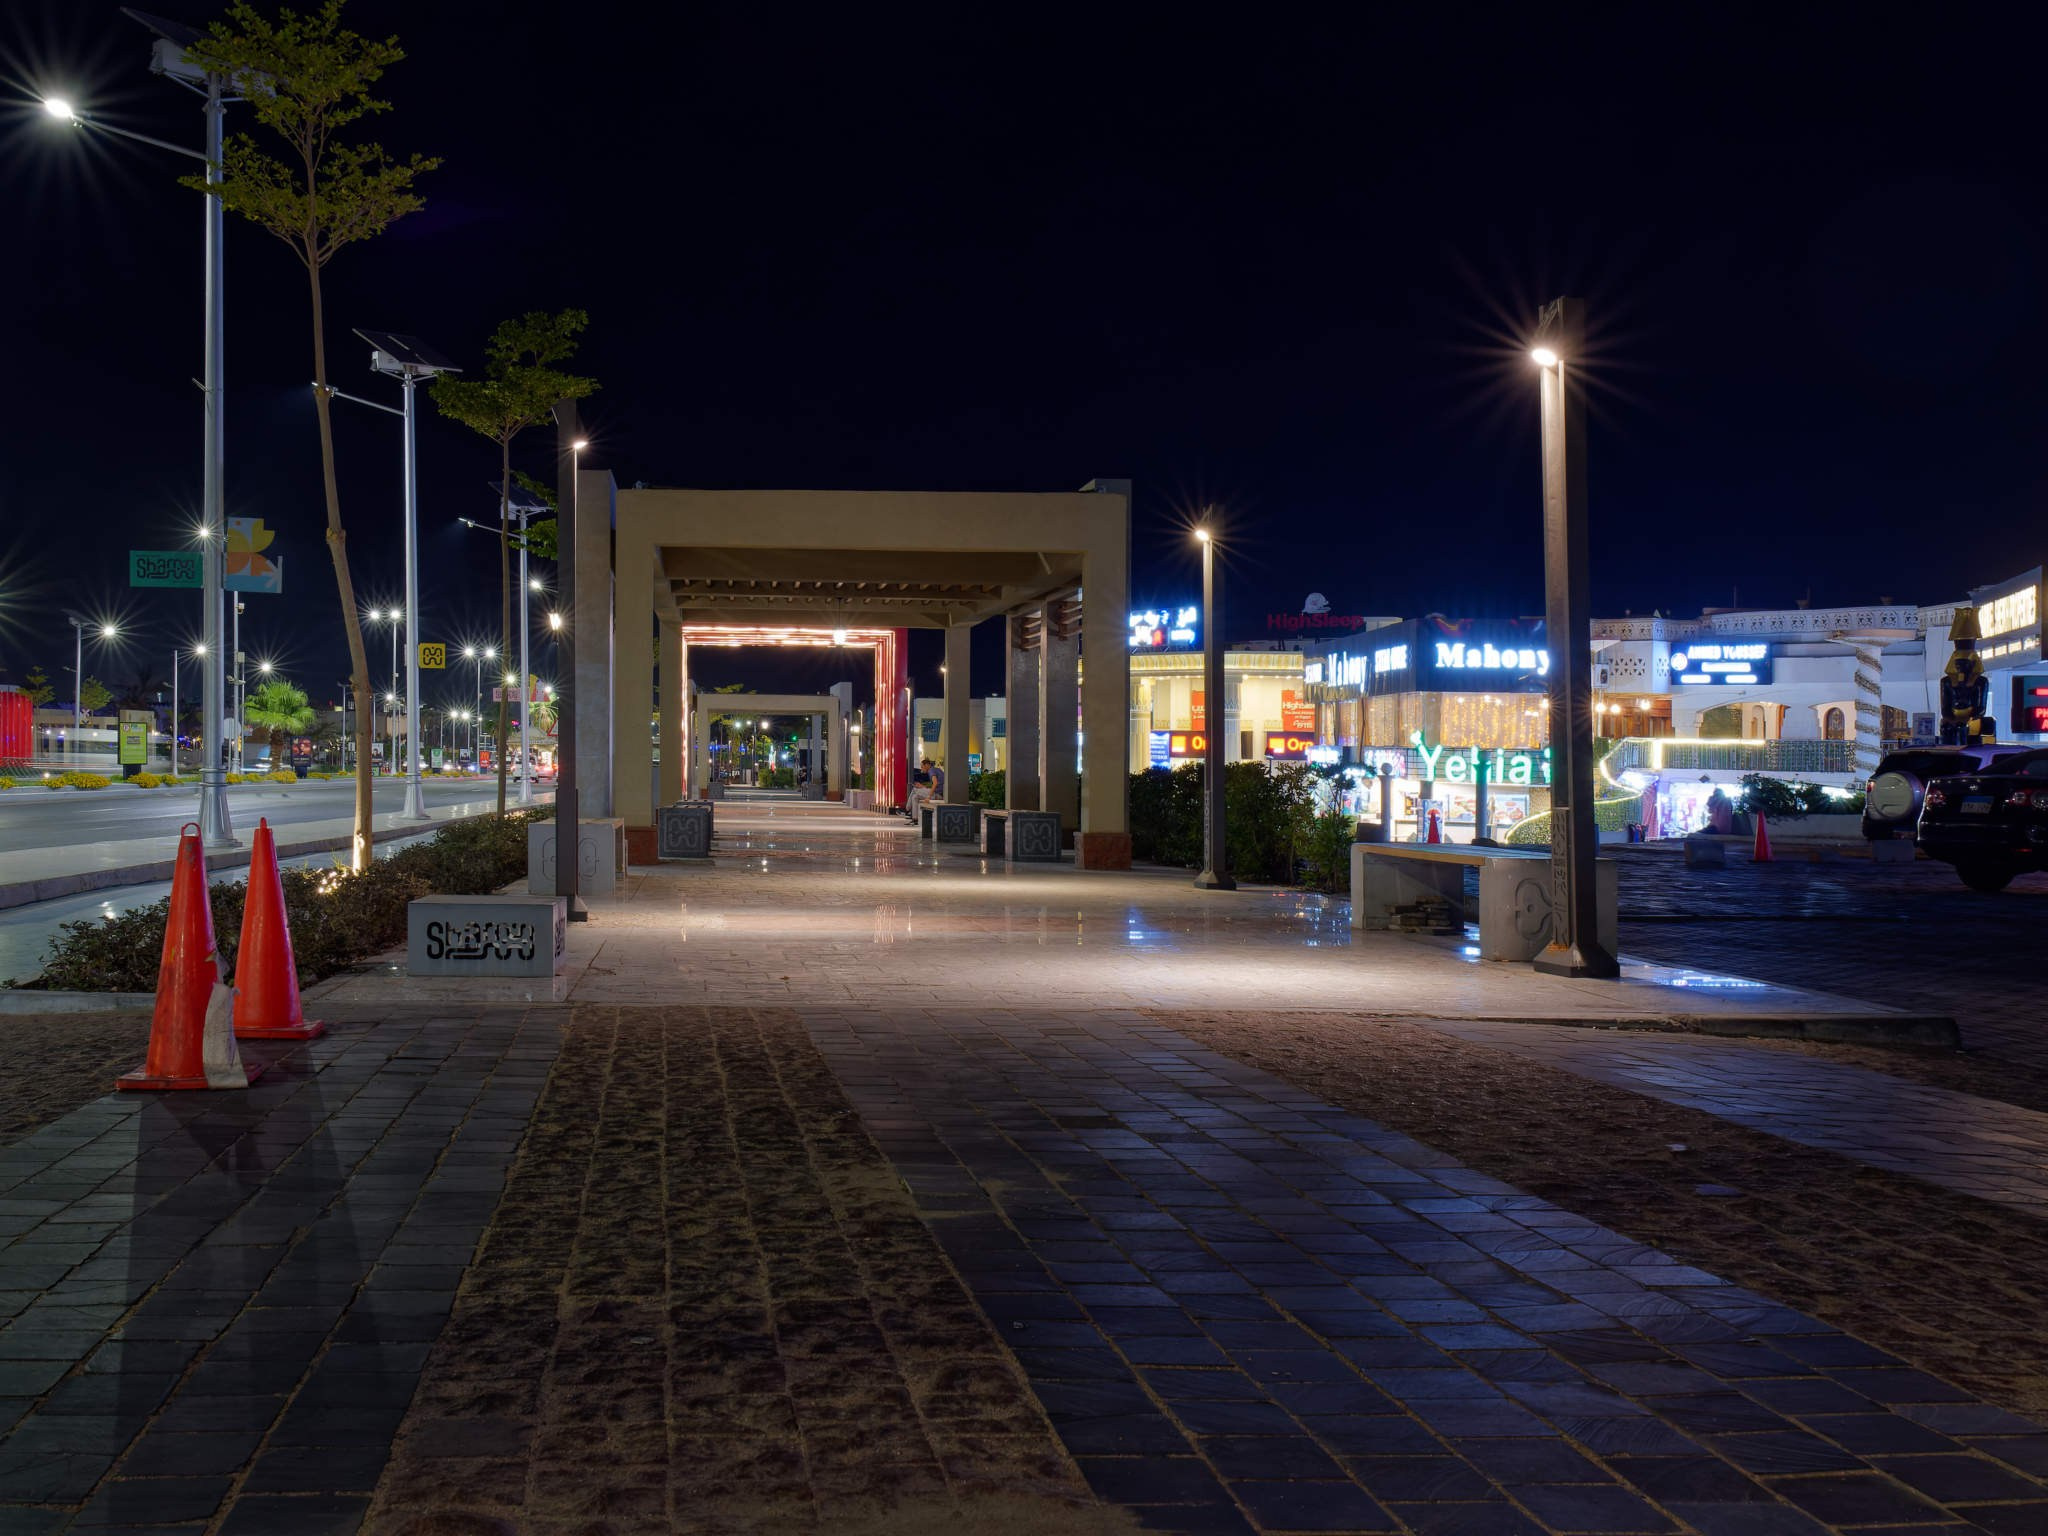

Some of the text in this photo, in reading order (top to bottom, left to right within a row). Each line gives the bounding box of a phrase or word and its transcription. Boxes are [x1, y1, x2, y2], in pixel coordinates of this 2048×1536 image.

[1267, 612, 1364, 631] HighSleep
[1327, 650, 1367, 694] Mahony
[1435, 642, 1549, 676] Mahony
[1416, 742, 1533, 784] Yehia
